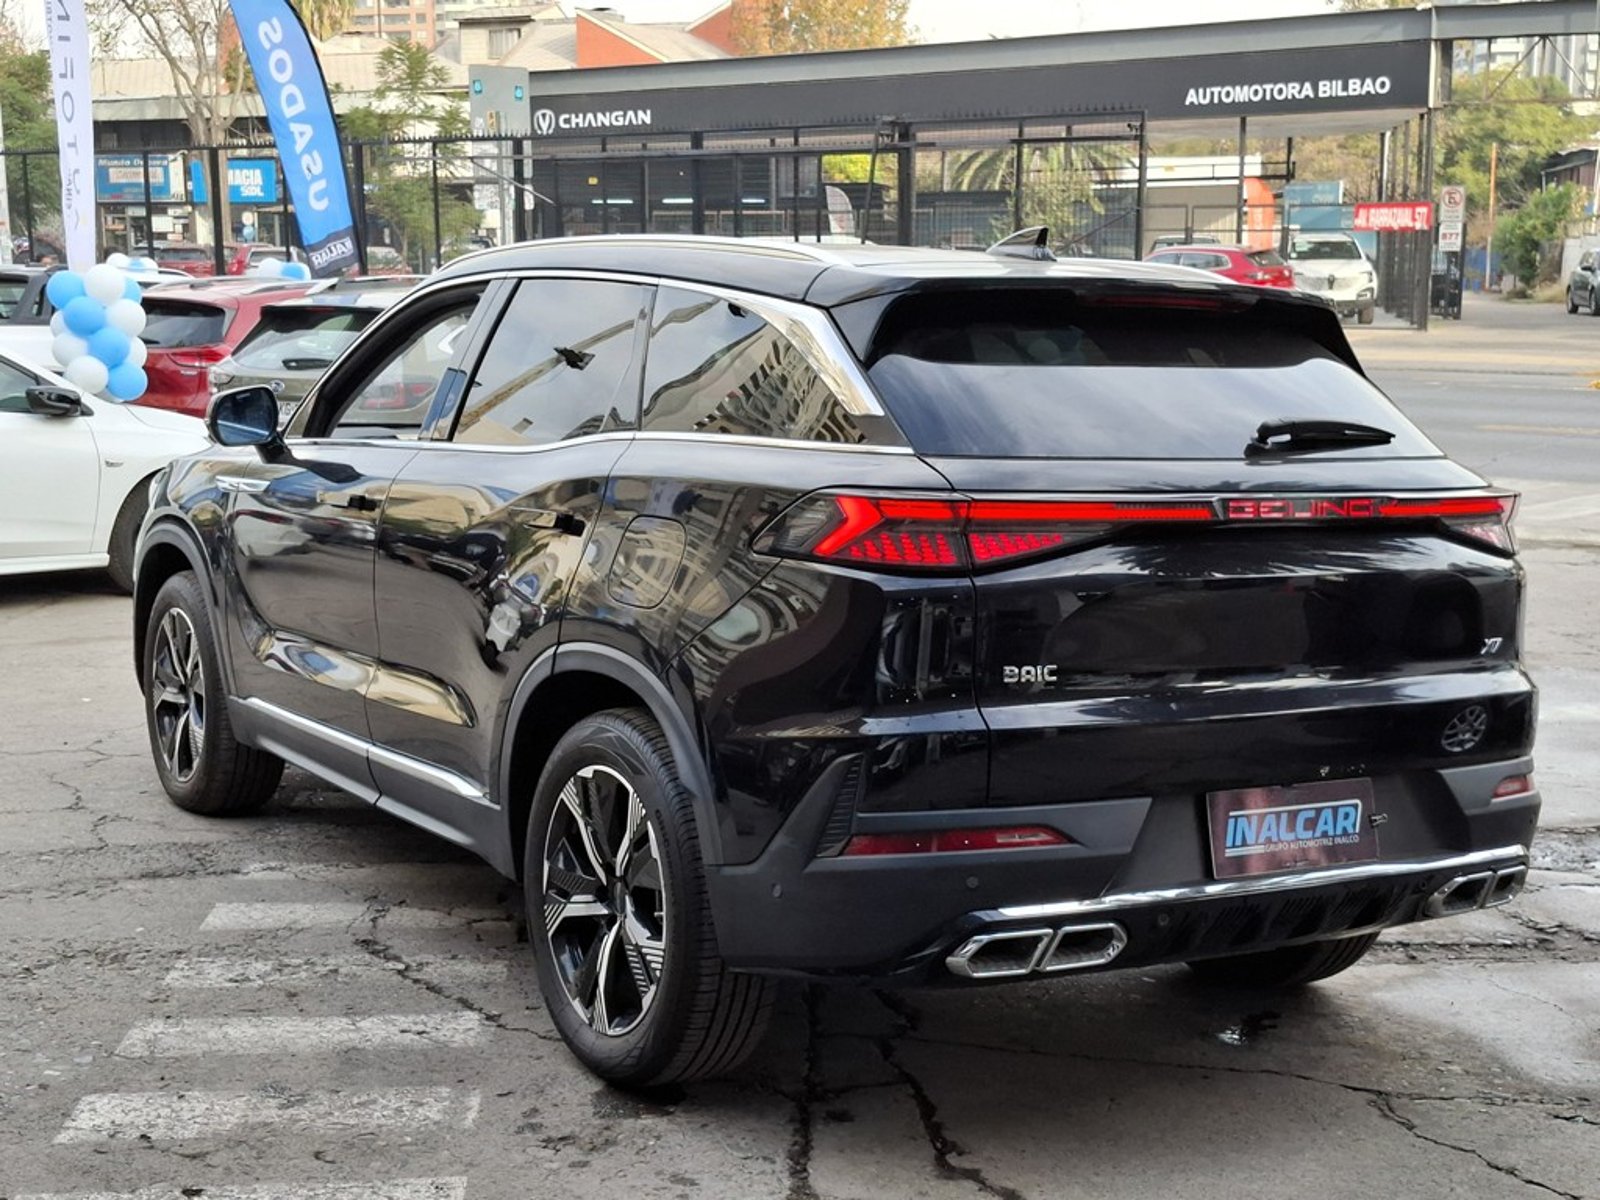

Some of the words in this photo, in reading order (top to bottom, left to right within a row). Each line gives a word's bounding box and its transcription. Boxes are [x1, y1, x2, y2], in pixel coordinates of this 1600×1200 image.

[1185, 81, 1314, 105] AUTOMOTORA
[1318, 76, 1390, 98] BILBAO
[558, 109, 652, 129] CHANGAN
[1003, 665, 1057, 683] BAIC
[1226, 805, 1357, 848] INALCAR
